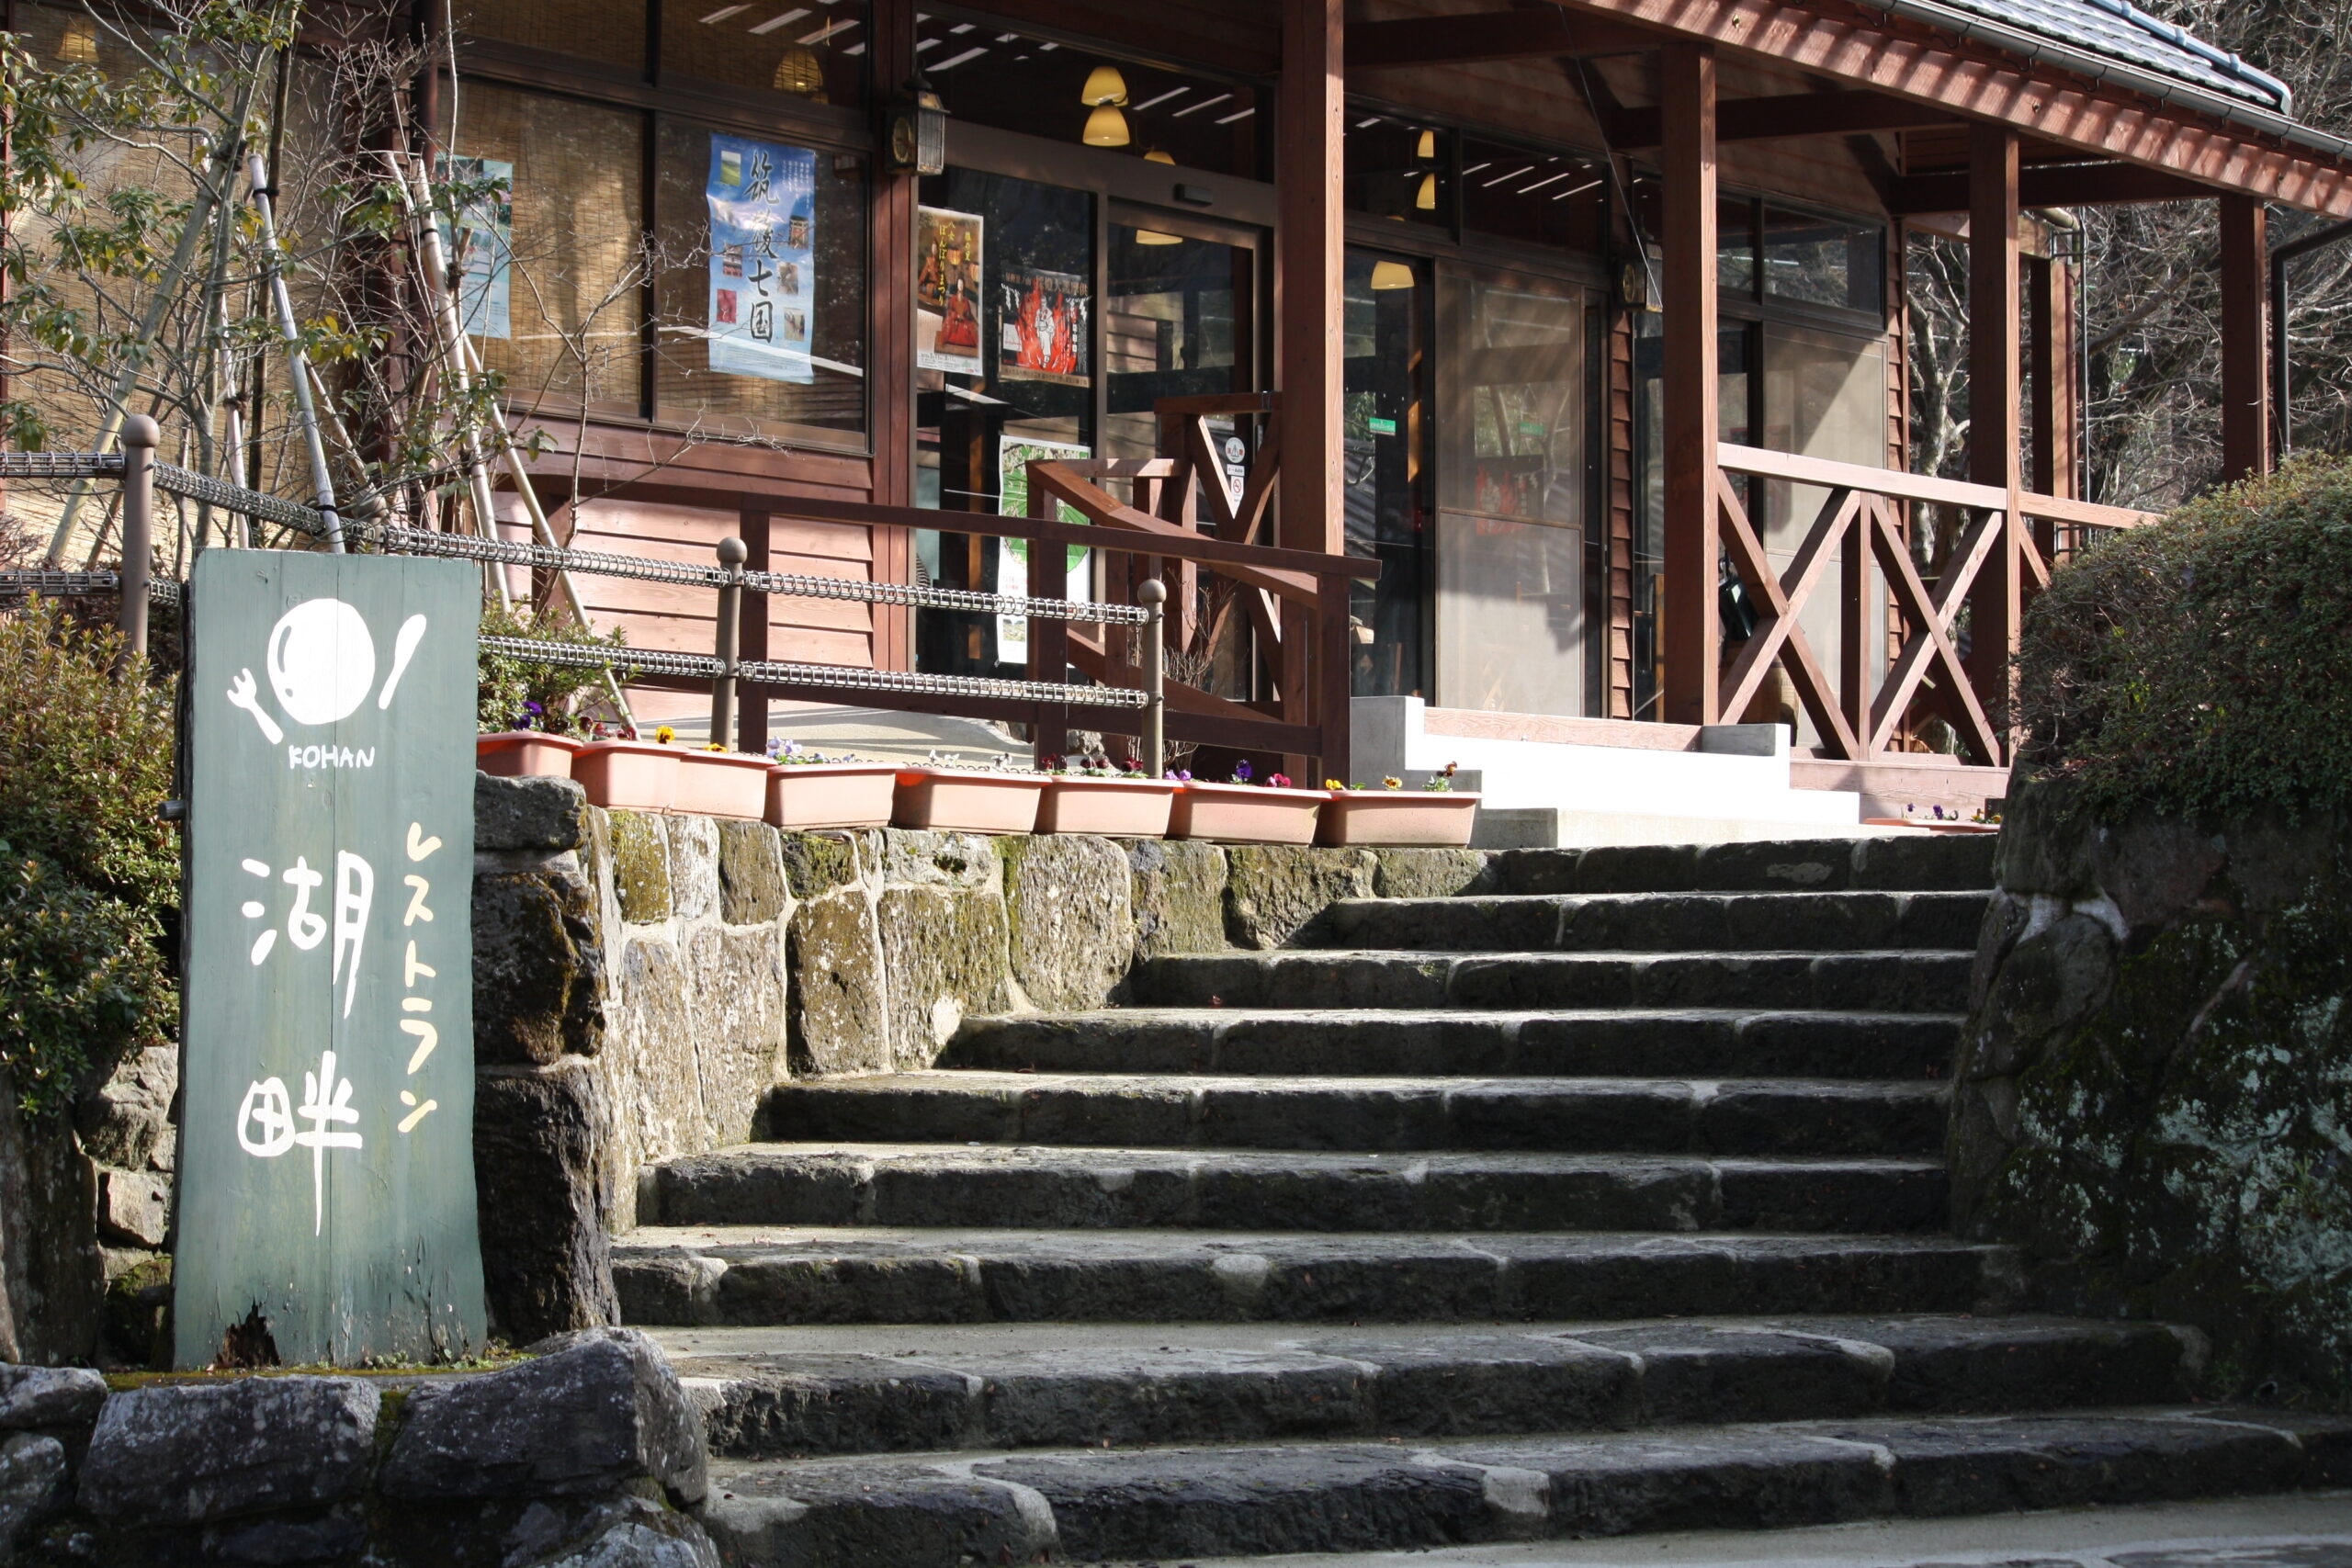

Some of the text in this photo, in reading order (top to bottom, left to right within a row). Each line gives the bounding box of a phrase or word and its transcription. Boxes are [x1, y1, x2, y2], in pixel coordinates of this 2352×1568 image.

[743, 151, 779, 344] 筑後七国
[938, 223, 948, 307] ぼんぼりまつり
[288, 744, 375, 770] KOHAN
[237, 849, 375, 1237] 湖畔
[398, 821, 443, 1135] レストラン
